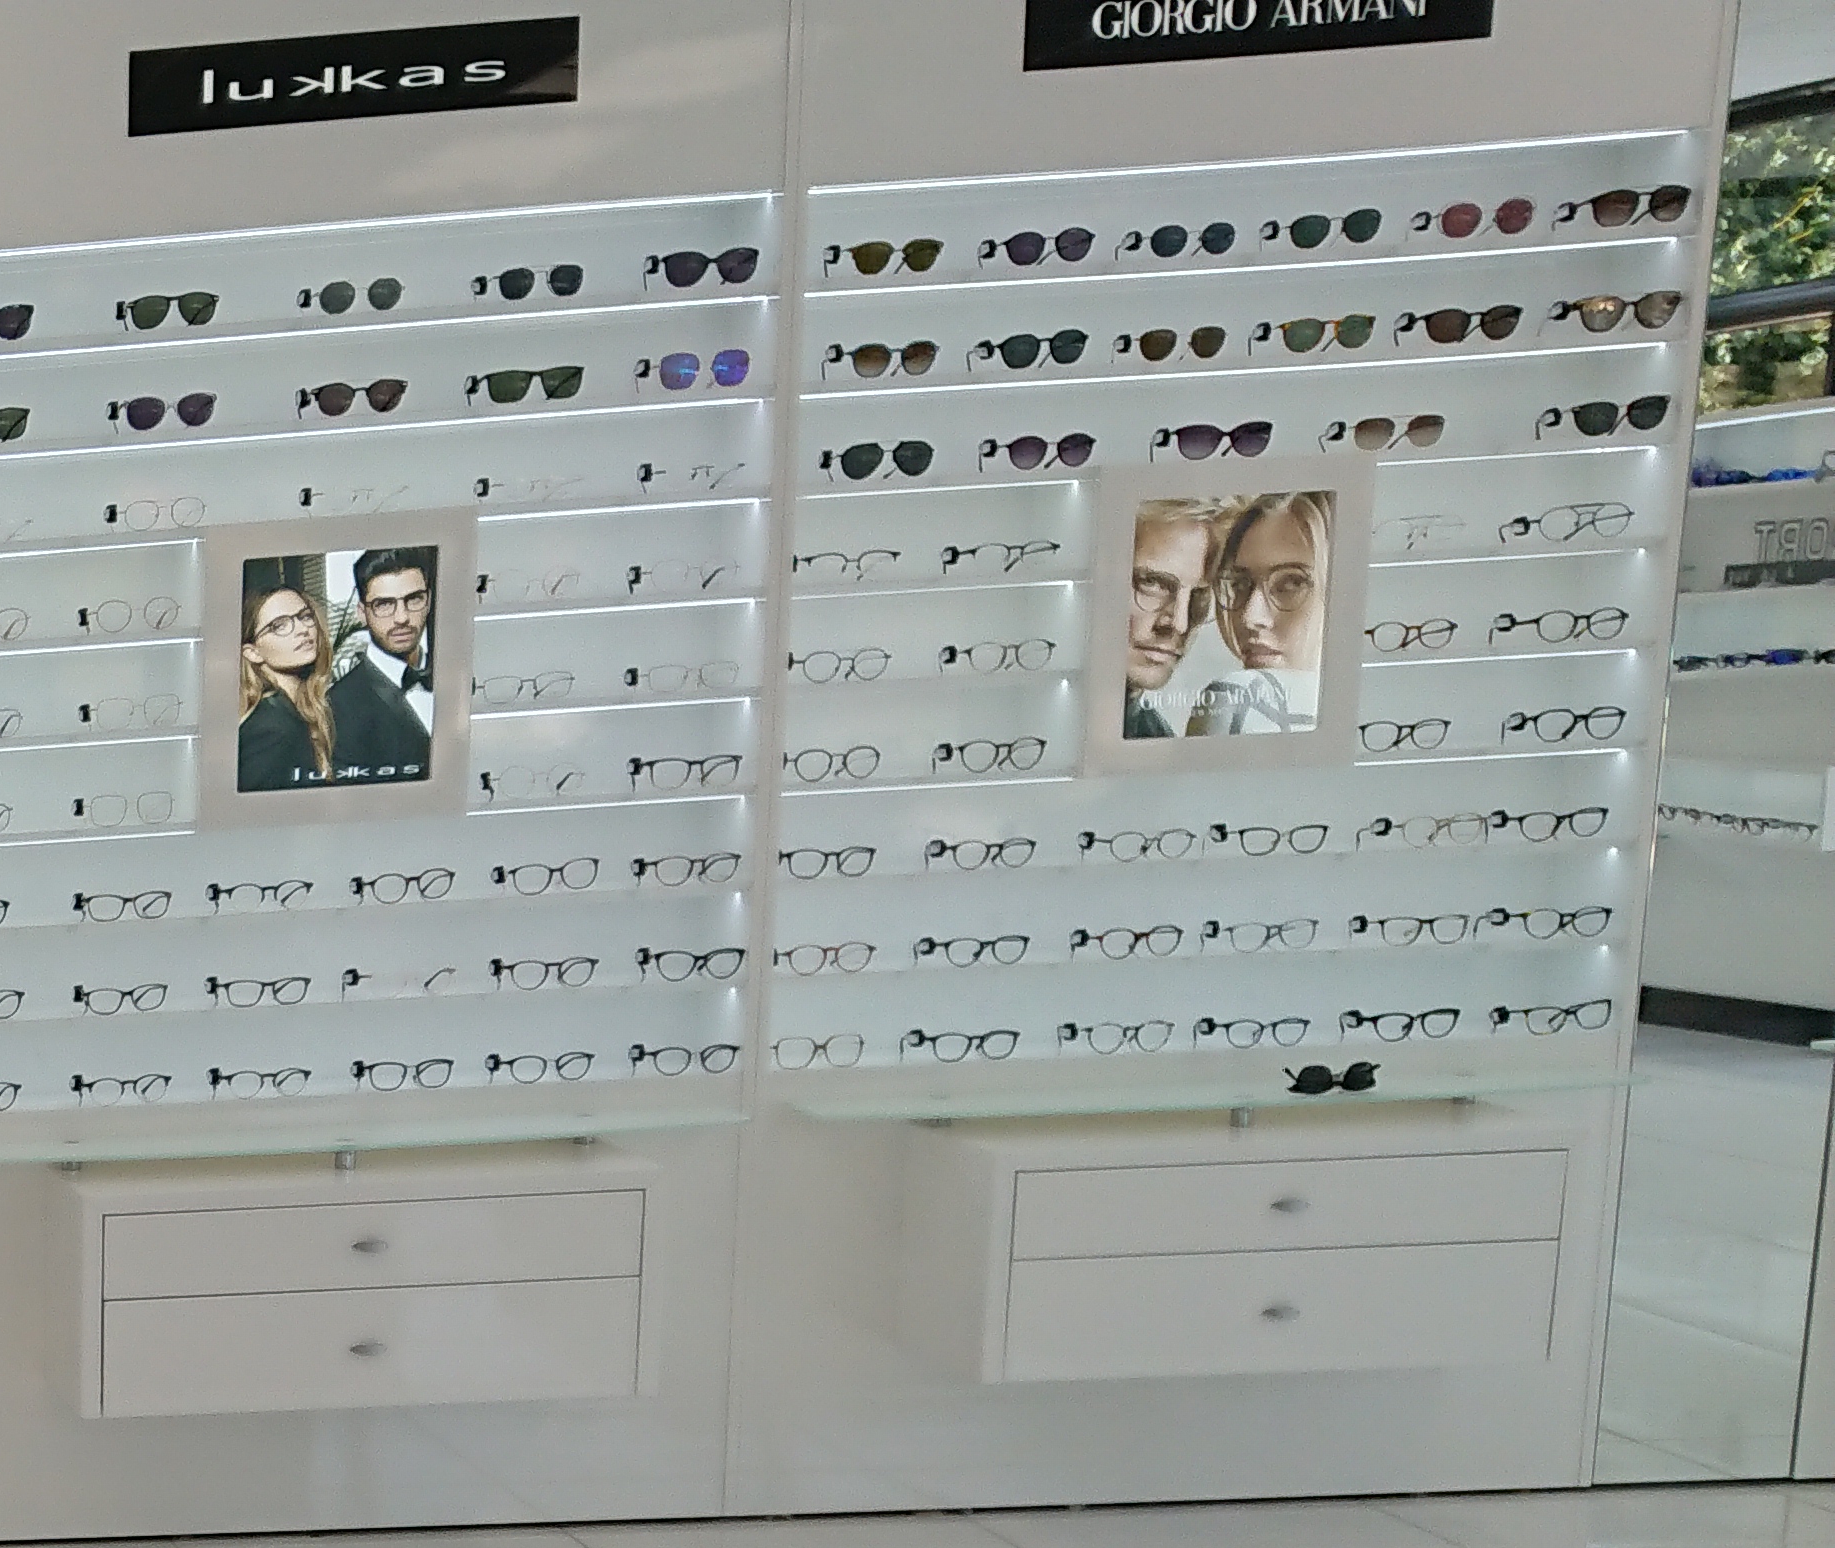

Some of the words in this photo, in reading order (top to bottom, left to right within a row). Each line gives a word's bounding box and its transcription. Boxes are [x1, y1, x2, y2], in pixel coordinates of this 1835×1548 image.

[1092, 0, 1257, 39] GIORGIO
[201, 60, 506, 104] lukkas
[292, 763, 421, 782] lukkas
